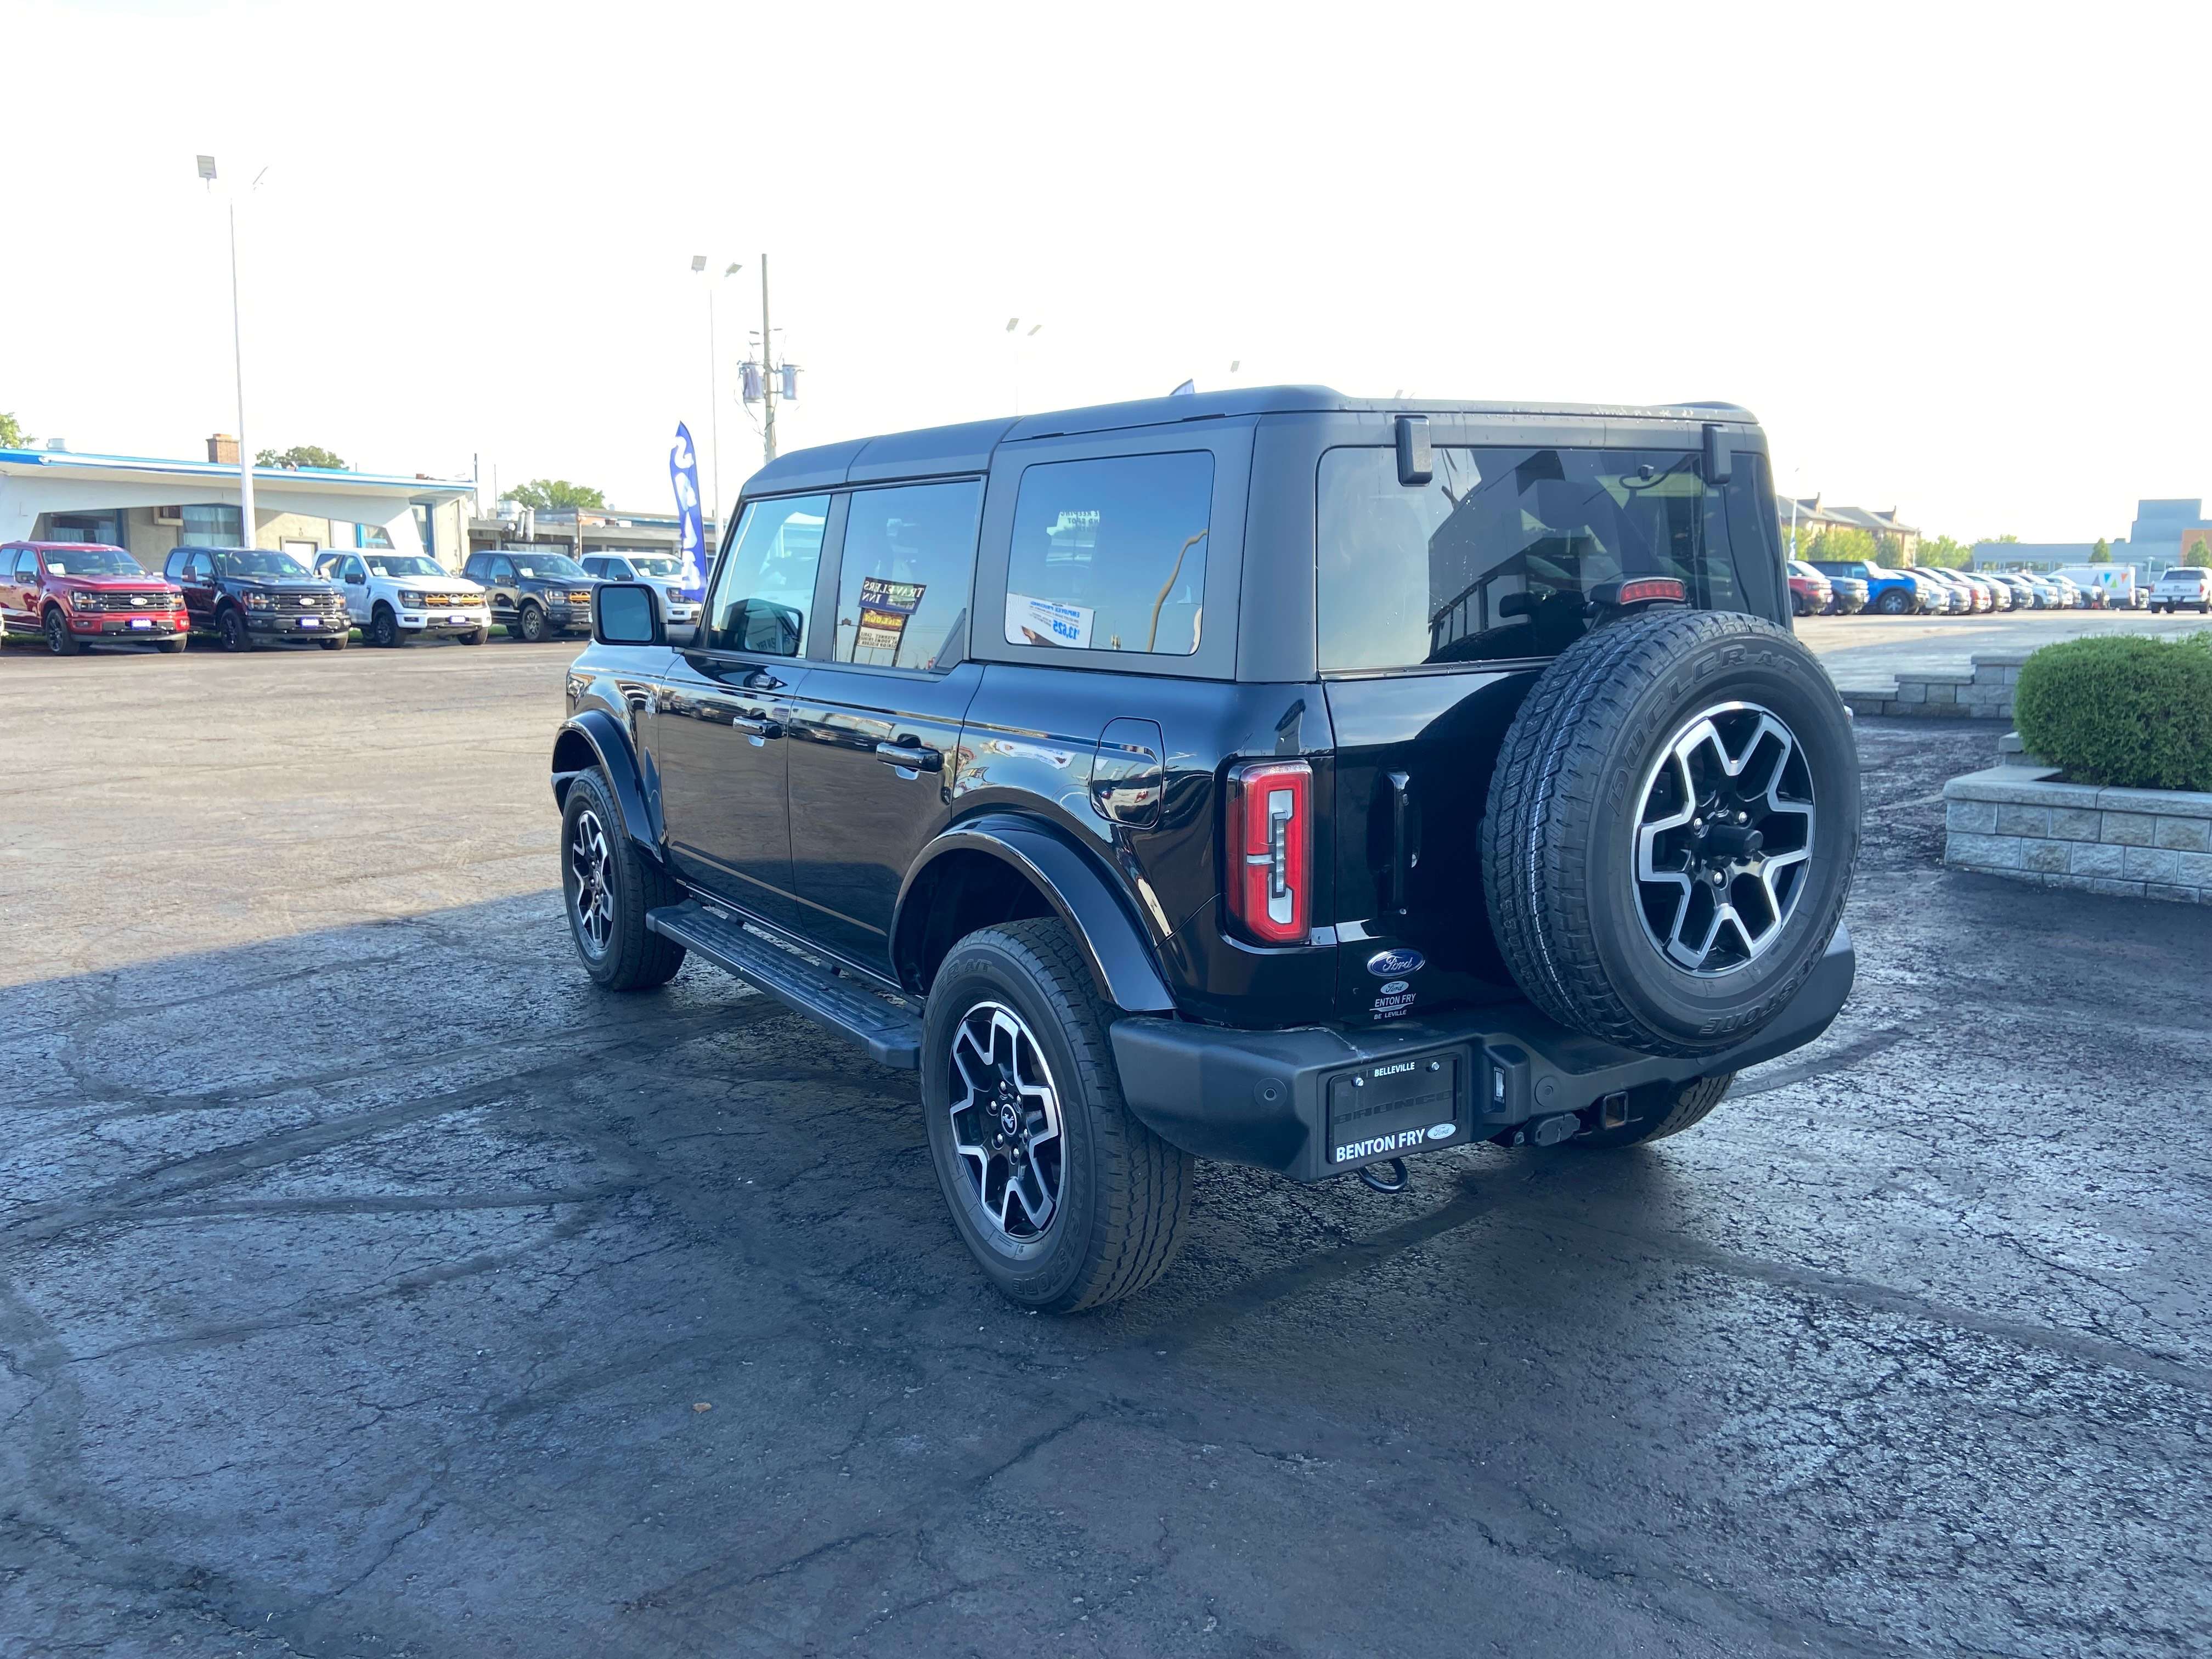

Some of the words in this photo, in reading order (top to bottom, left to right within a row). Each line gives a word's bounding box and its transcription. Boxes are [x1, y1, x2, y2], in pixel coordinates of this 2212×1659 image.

[1382, 953, 1413, 972] Ford
[1385, 983, 1405, 993] Ford
[1402, 993, 1417, 1003] FRY
[1374, 1062, 1415, 1077] BELLEVILLE
[1334, 1089, 1453, 1125] BRONCO
[1336, 1135, 1395, 1162] BENTON
[1399, 1128, 1425, 1148] FRY
[1433, 1126, 1450, 1136] Ford
